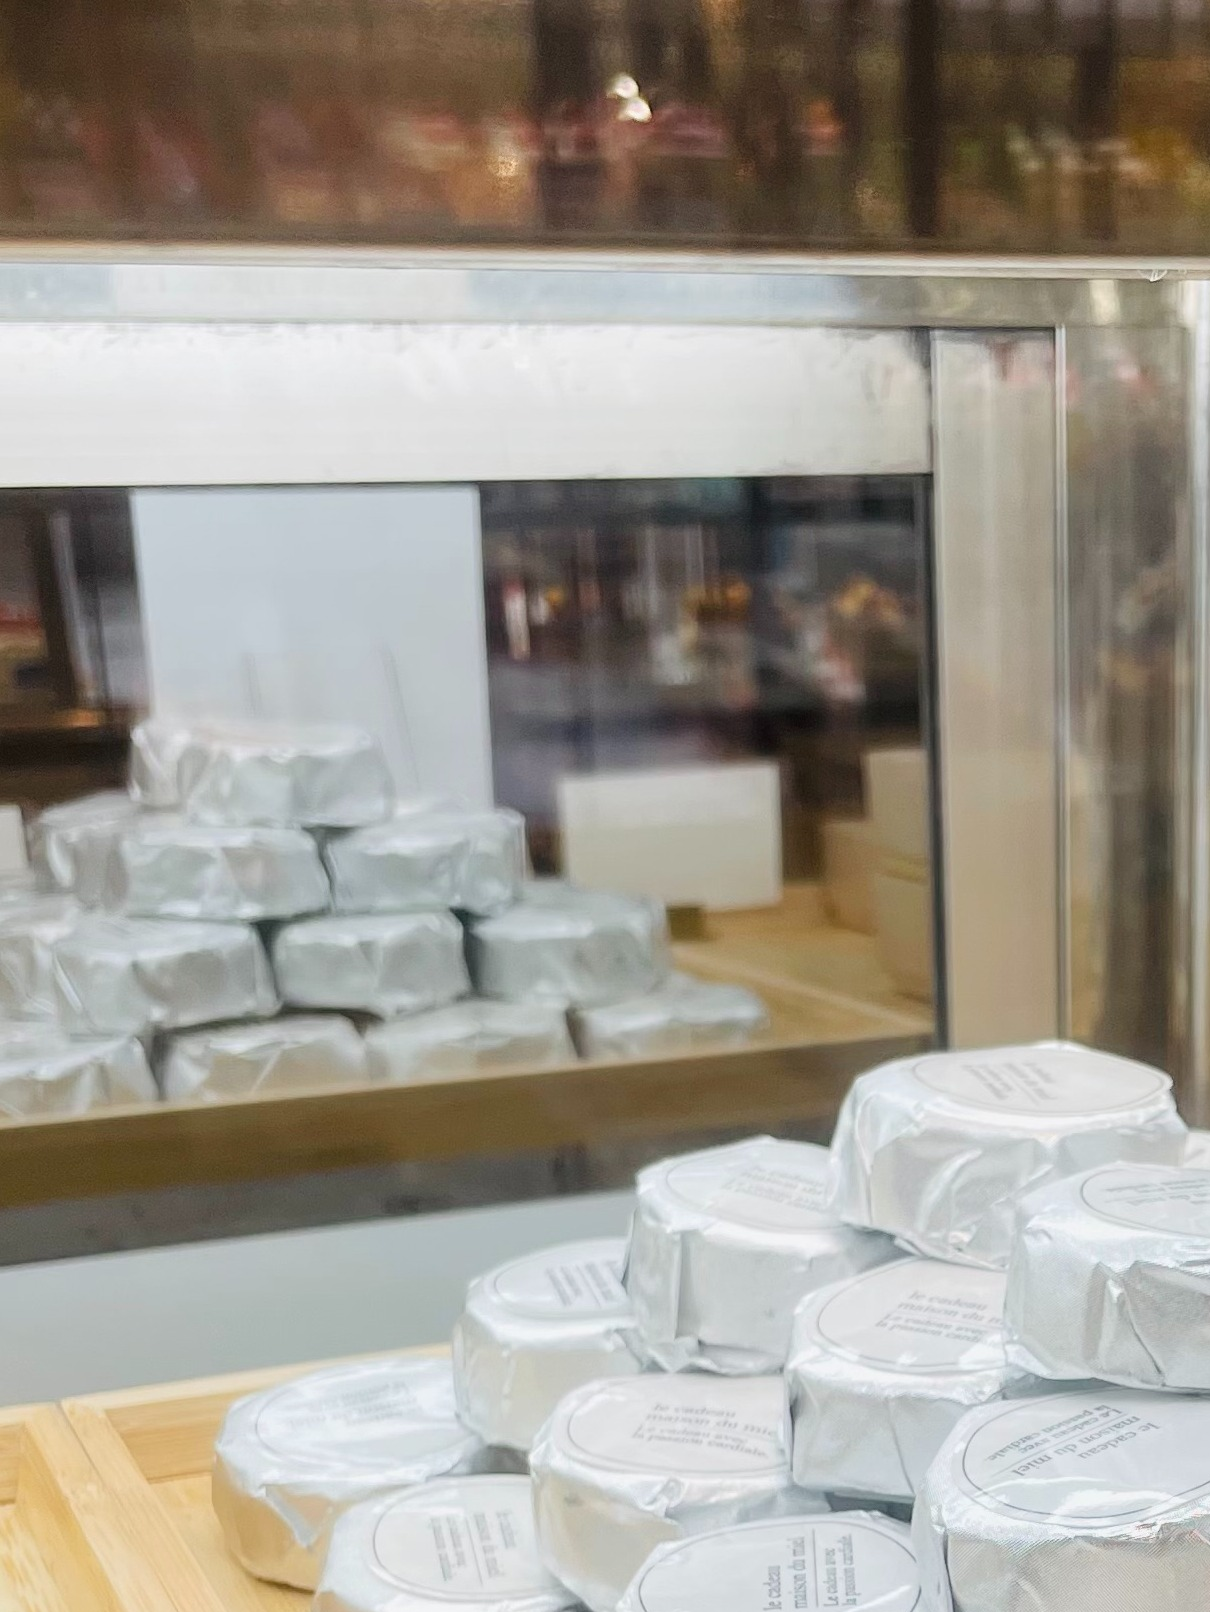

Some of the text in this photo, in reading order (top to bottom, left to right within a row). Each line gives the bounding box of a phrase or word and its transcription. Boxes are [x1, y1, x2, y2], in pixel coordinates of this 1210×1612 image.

[1011, 1415, 1140, 1477] maison du miel
[1077, 1422, 1161, 1459] le cadeau
[763, 1566, 781, 1598] cadeau
[788, 1573, 807, 1609] maison
